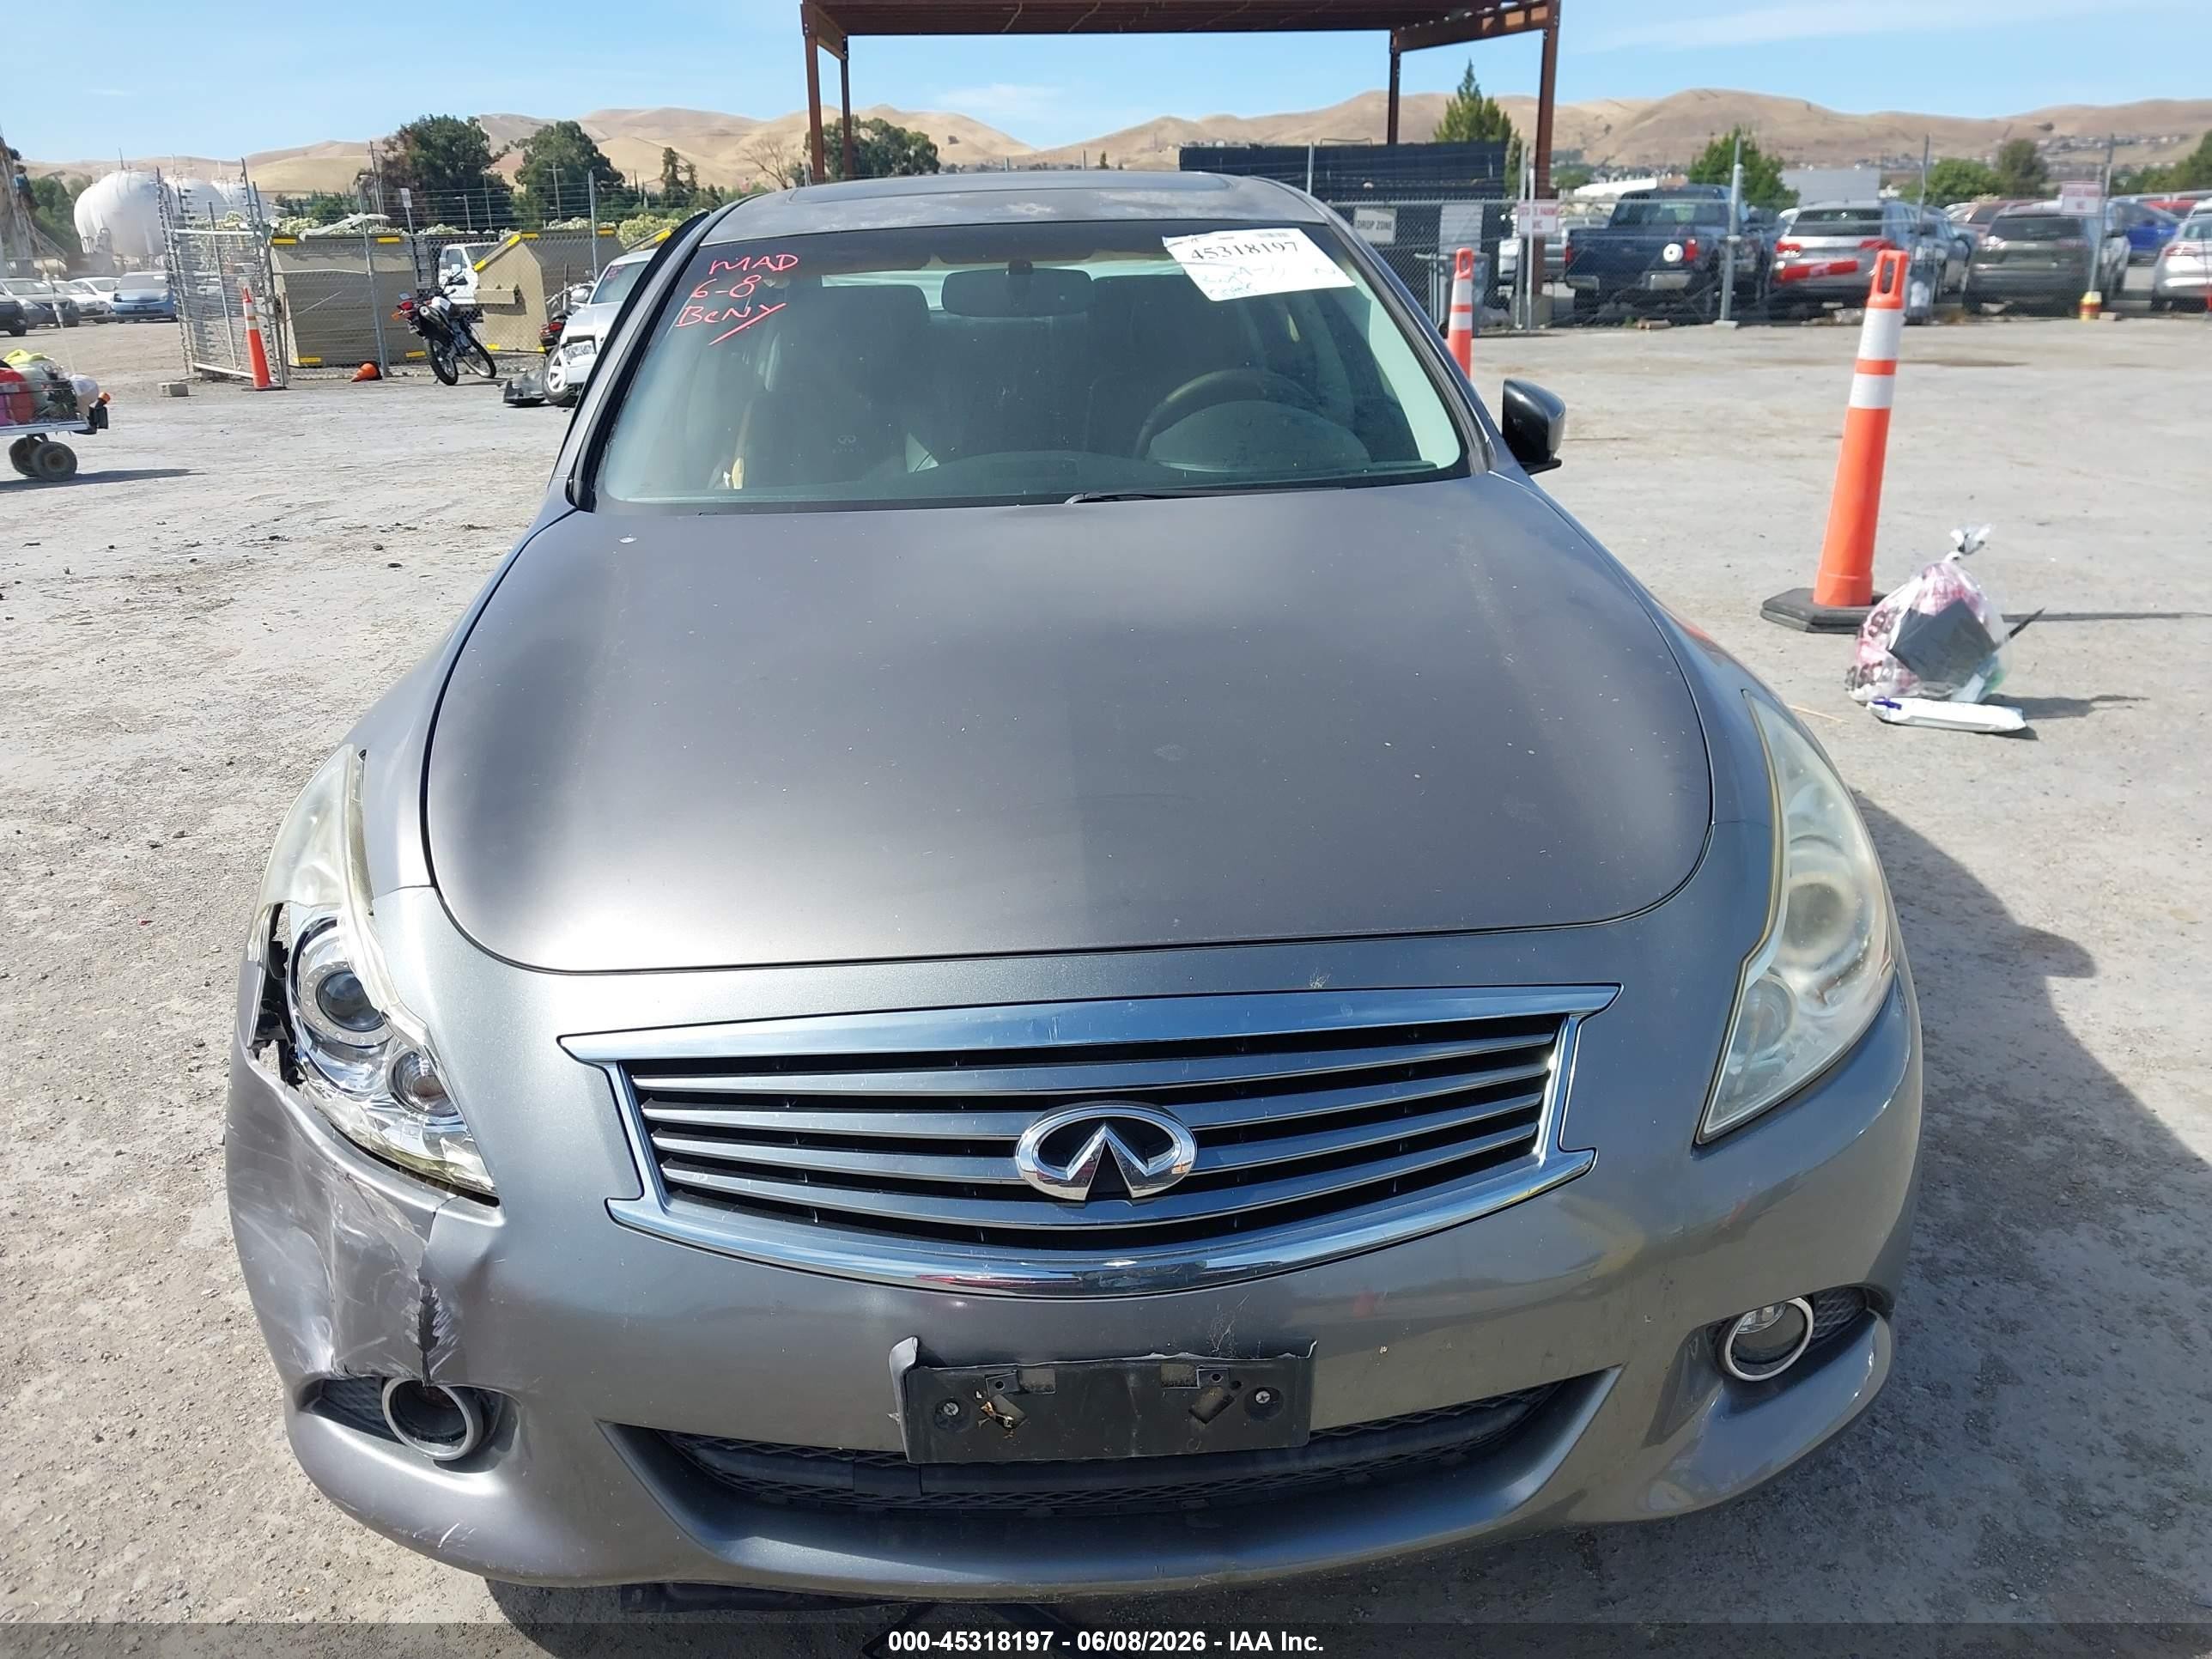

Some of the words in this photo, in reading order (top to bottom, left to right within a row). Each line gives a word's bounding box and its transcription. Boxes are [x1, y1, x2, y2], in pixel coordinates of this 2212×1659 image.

[1357, 220, 1374, 230] DROP
[1376, 220, 1392, 230] ZONE
[1190, 240, 1299, 260] 45318197
[708, 254, 799, 275] MAD
[690, 274, 763, 298] 6-8
